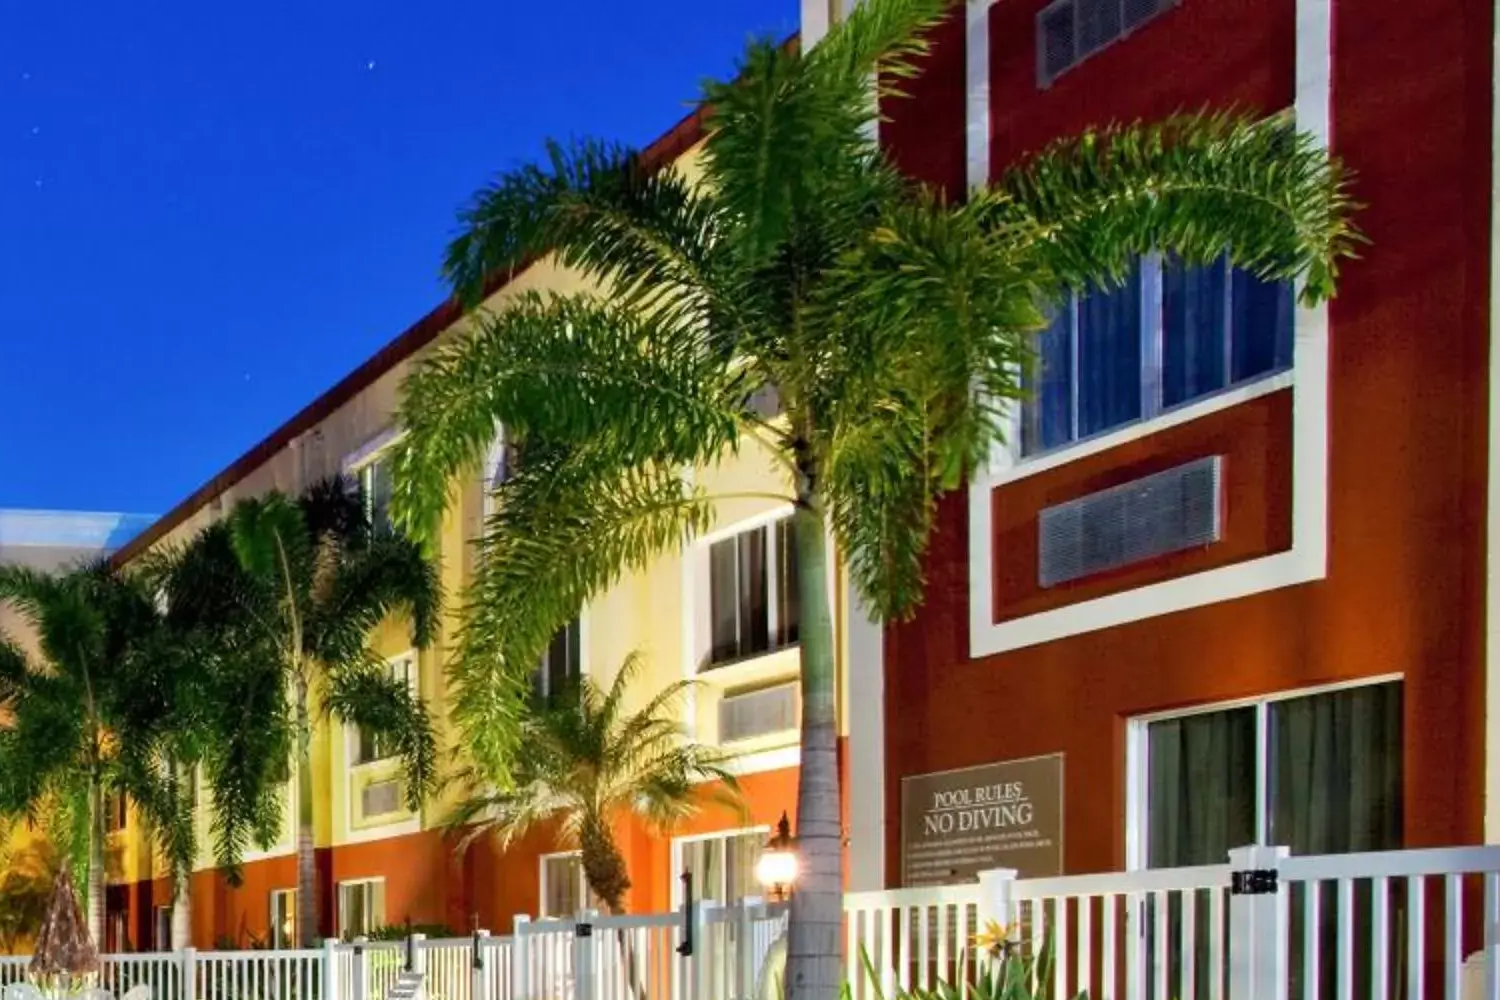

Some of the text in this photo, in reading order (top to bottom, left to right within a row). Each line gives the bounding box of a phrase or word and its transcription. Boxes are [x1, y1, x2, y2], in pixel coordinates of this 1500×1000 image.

[934, 781, 1023, 808] POOL RULES
[924, 803, 1033, 835] NO DIVING
